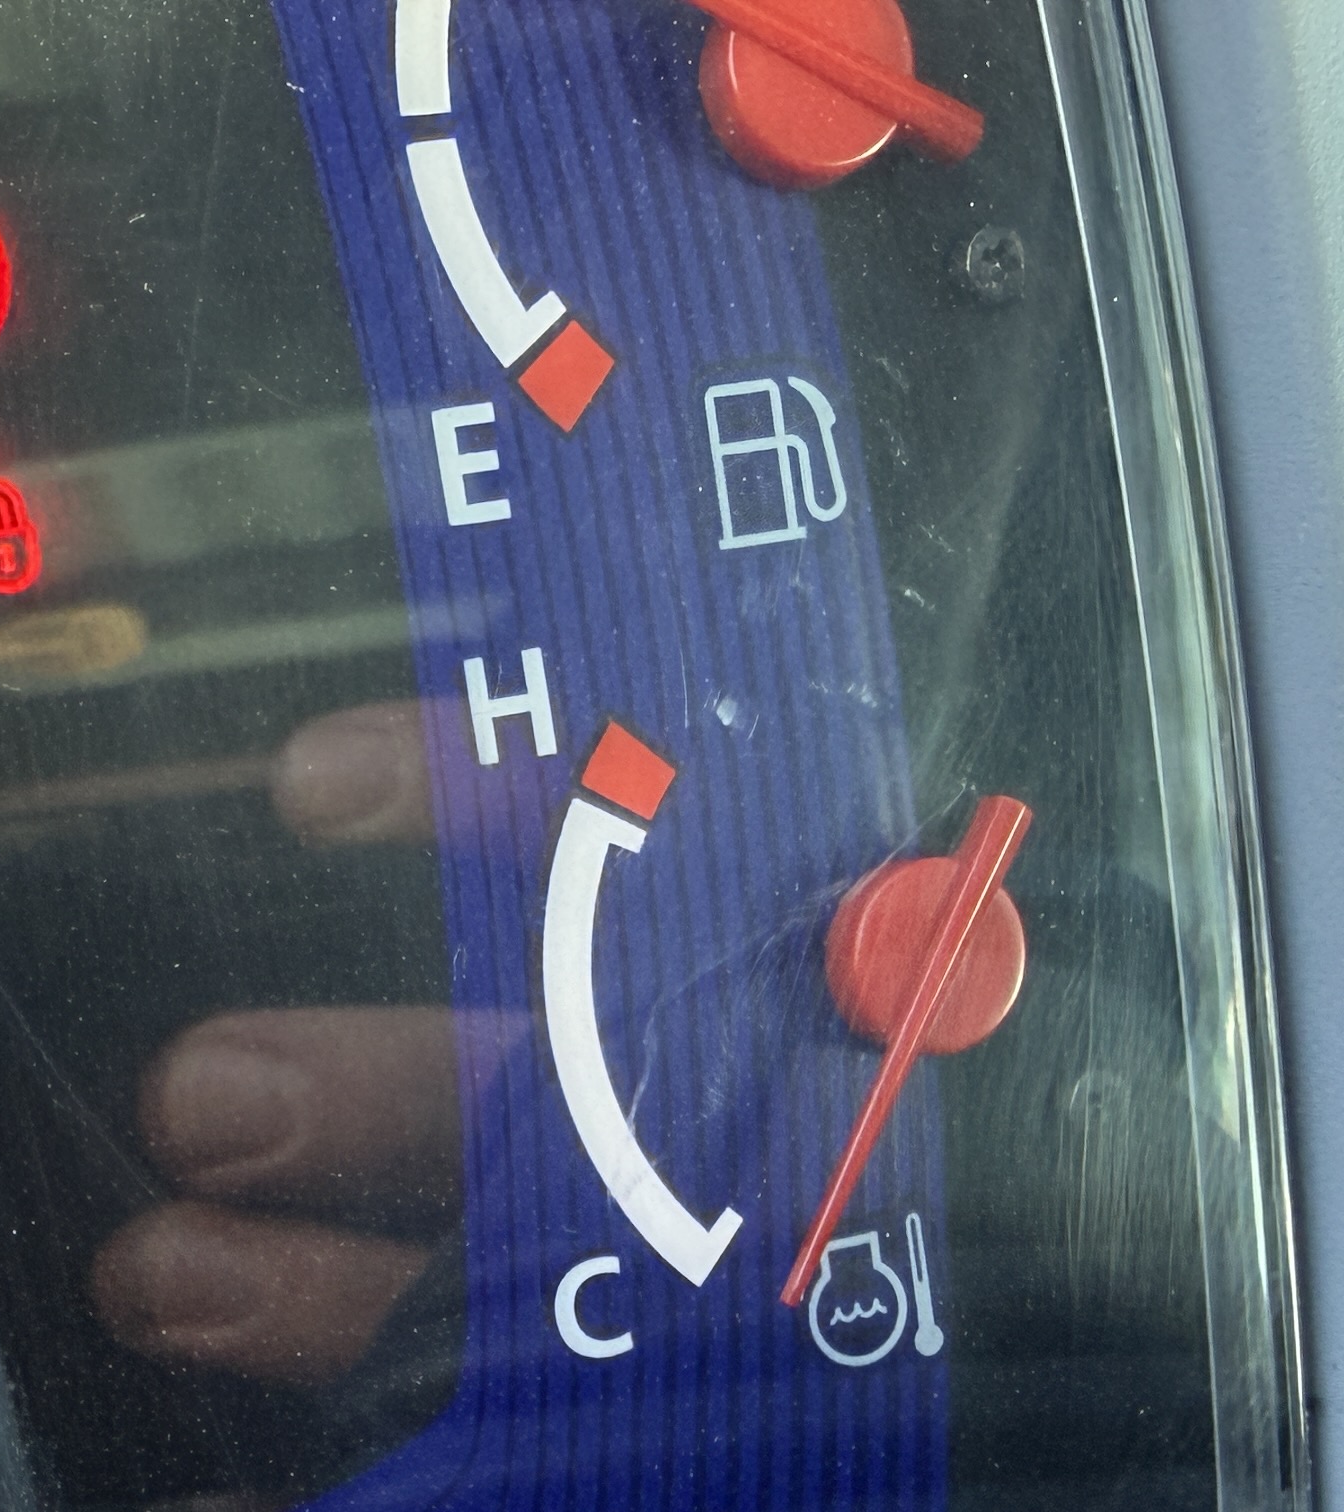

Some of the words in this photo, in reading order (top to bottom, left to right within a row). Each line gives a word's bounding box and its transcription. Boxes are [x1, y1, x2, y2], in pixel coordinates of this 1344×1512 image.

[431, 402, 512, 526] E
[463, 647, 557, 766] H
[554, 1256, 635, 1359] C
